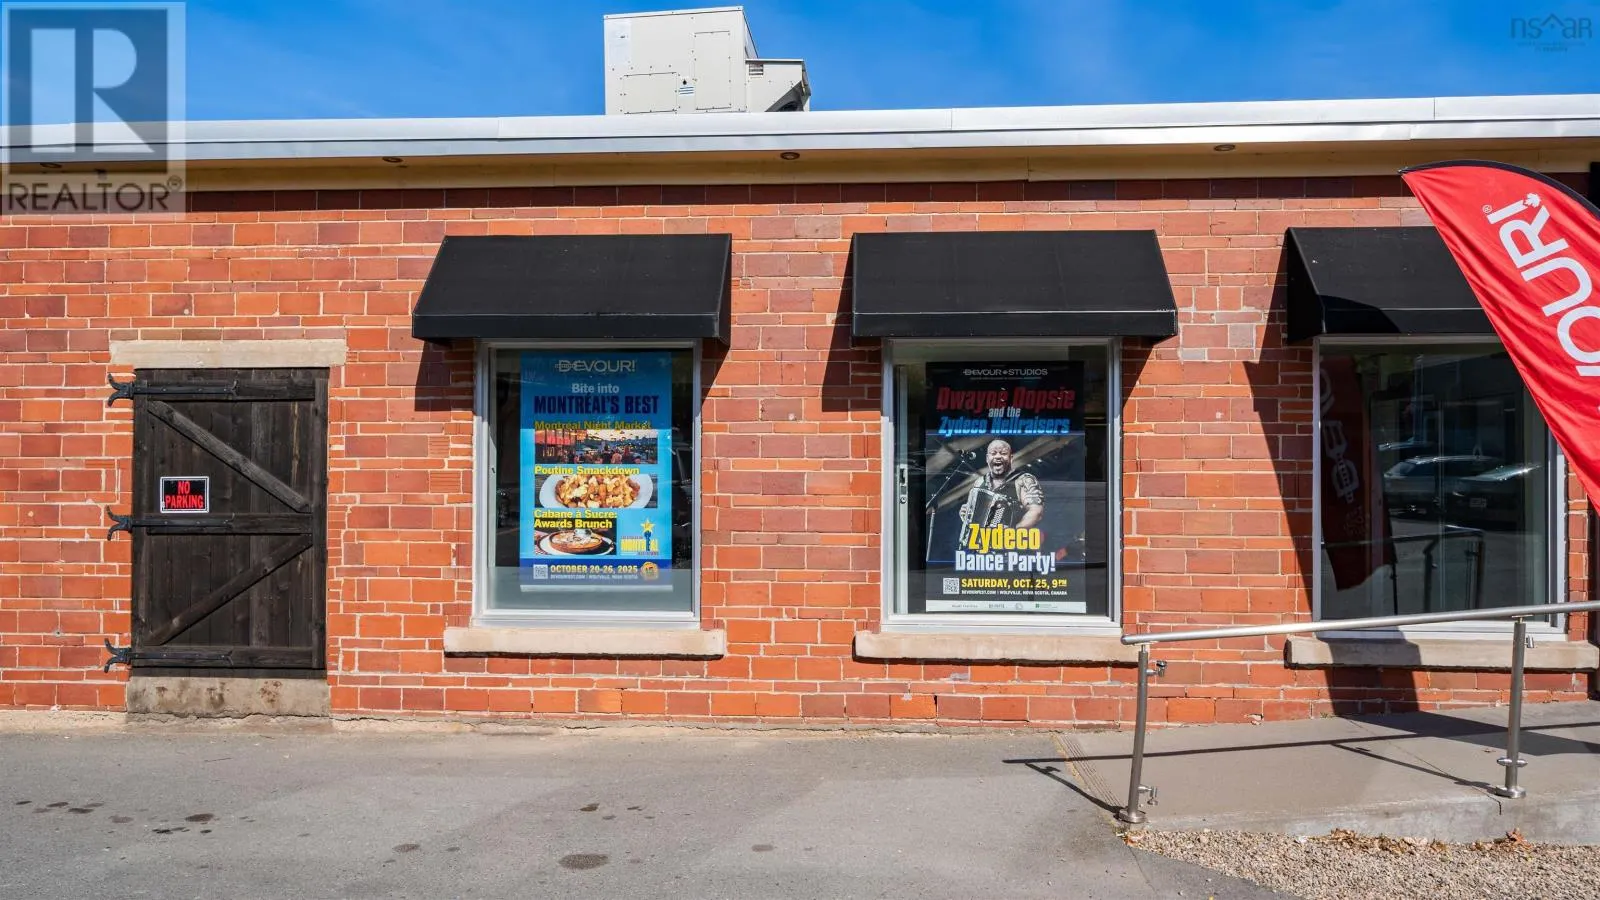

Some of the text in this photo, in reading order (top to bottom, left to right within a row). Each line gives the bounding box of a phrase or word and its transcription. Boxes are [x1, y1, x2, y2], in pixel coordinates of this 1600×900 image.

[555, 359, 636, 373] DEVOUR!
[963, 368, 1048, 376] DEVOUR STUDIOS
[572, 383, 620, 394] Bite into
[625, 395, 660, 414] BEST
[936, 387, 1009, 413] Dwayne
[988, 406, 1021, 417] and the
[583, 420, 611, 431] Night
[614, 420, 652, 430] Market
[938, 416, 1071, 437] Zydeco Hellraisers
[534, 465, 640, 475] Poutine Smackdown
[177, 481, 191, 495] NO
[165, 495, 204, 509] PARKING
[533, 509, 573, 519] Cabane
[584, 509, 618, 519] Sucre:
[534, 519, 613, 529] Awards Brunch
[968, 523, 1041, 554] Zydeco
[955, 550, 1056, 575] Dance Party!
[550, 565, 638, 575] OCTOBER 20-26, 2025
[961, 578, 1011, 590] SATURDAY,
[1013, 578, 1034, 588] OCT.
[1035, 579, 1050, 590] 25,
